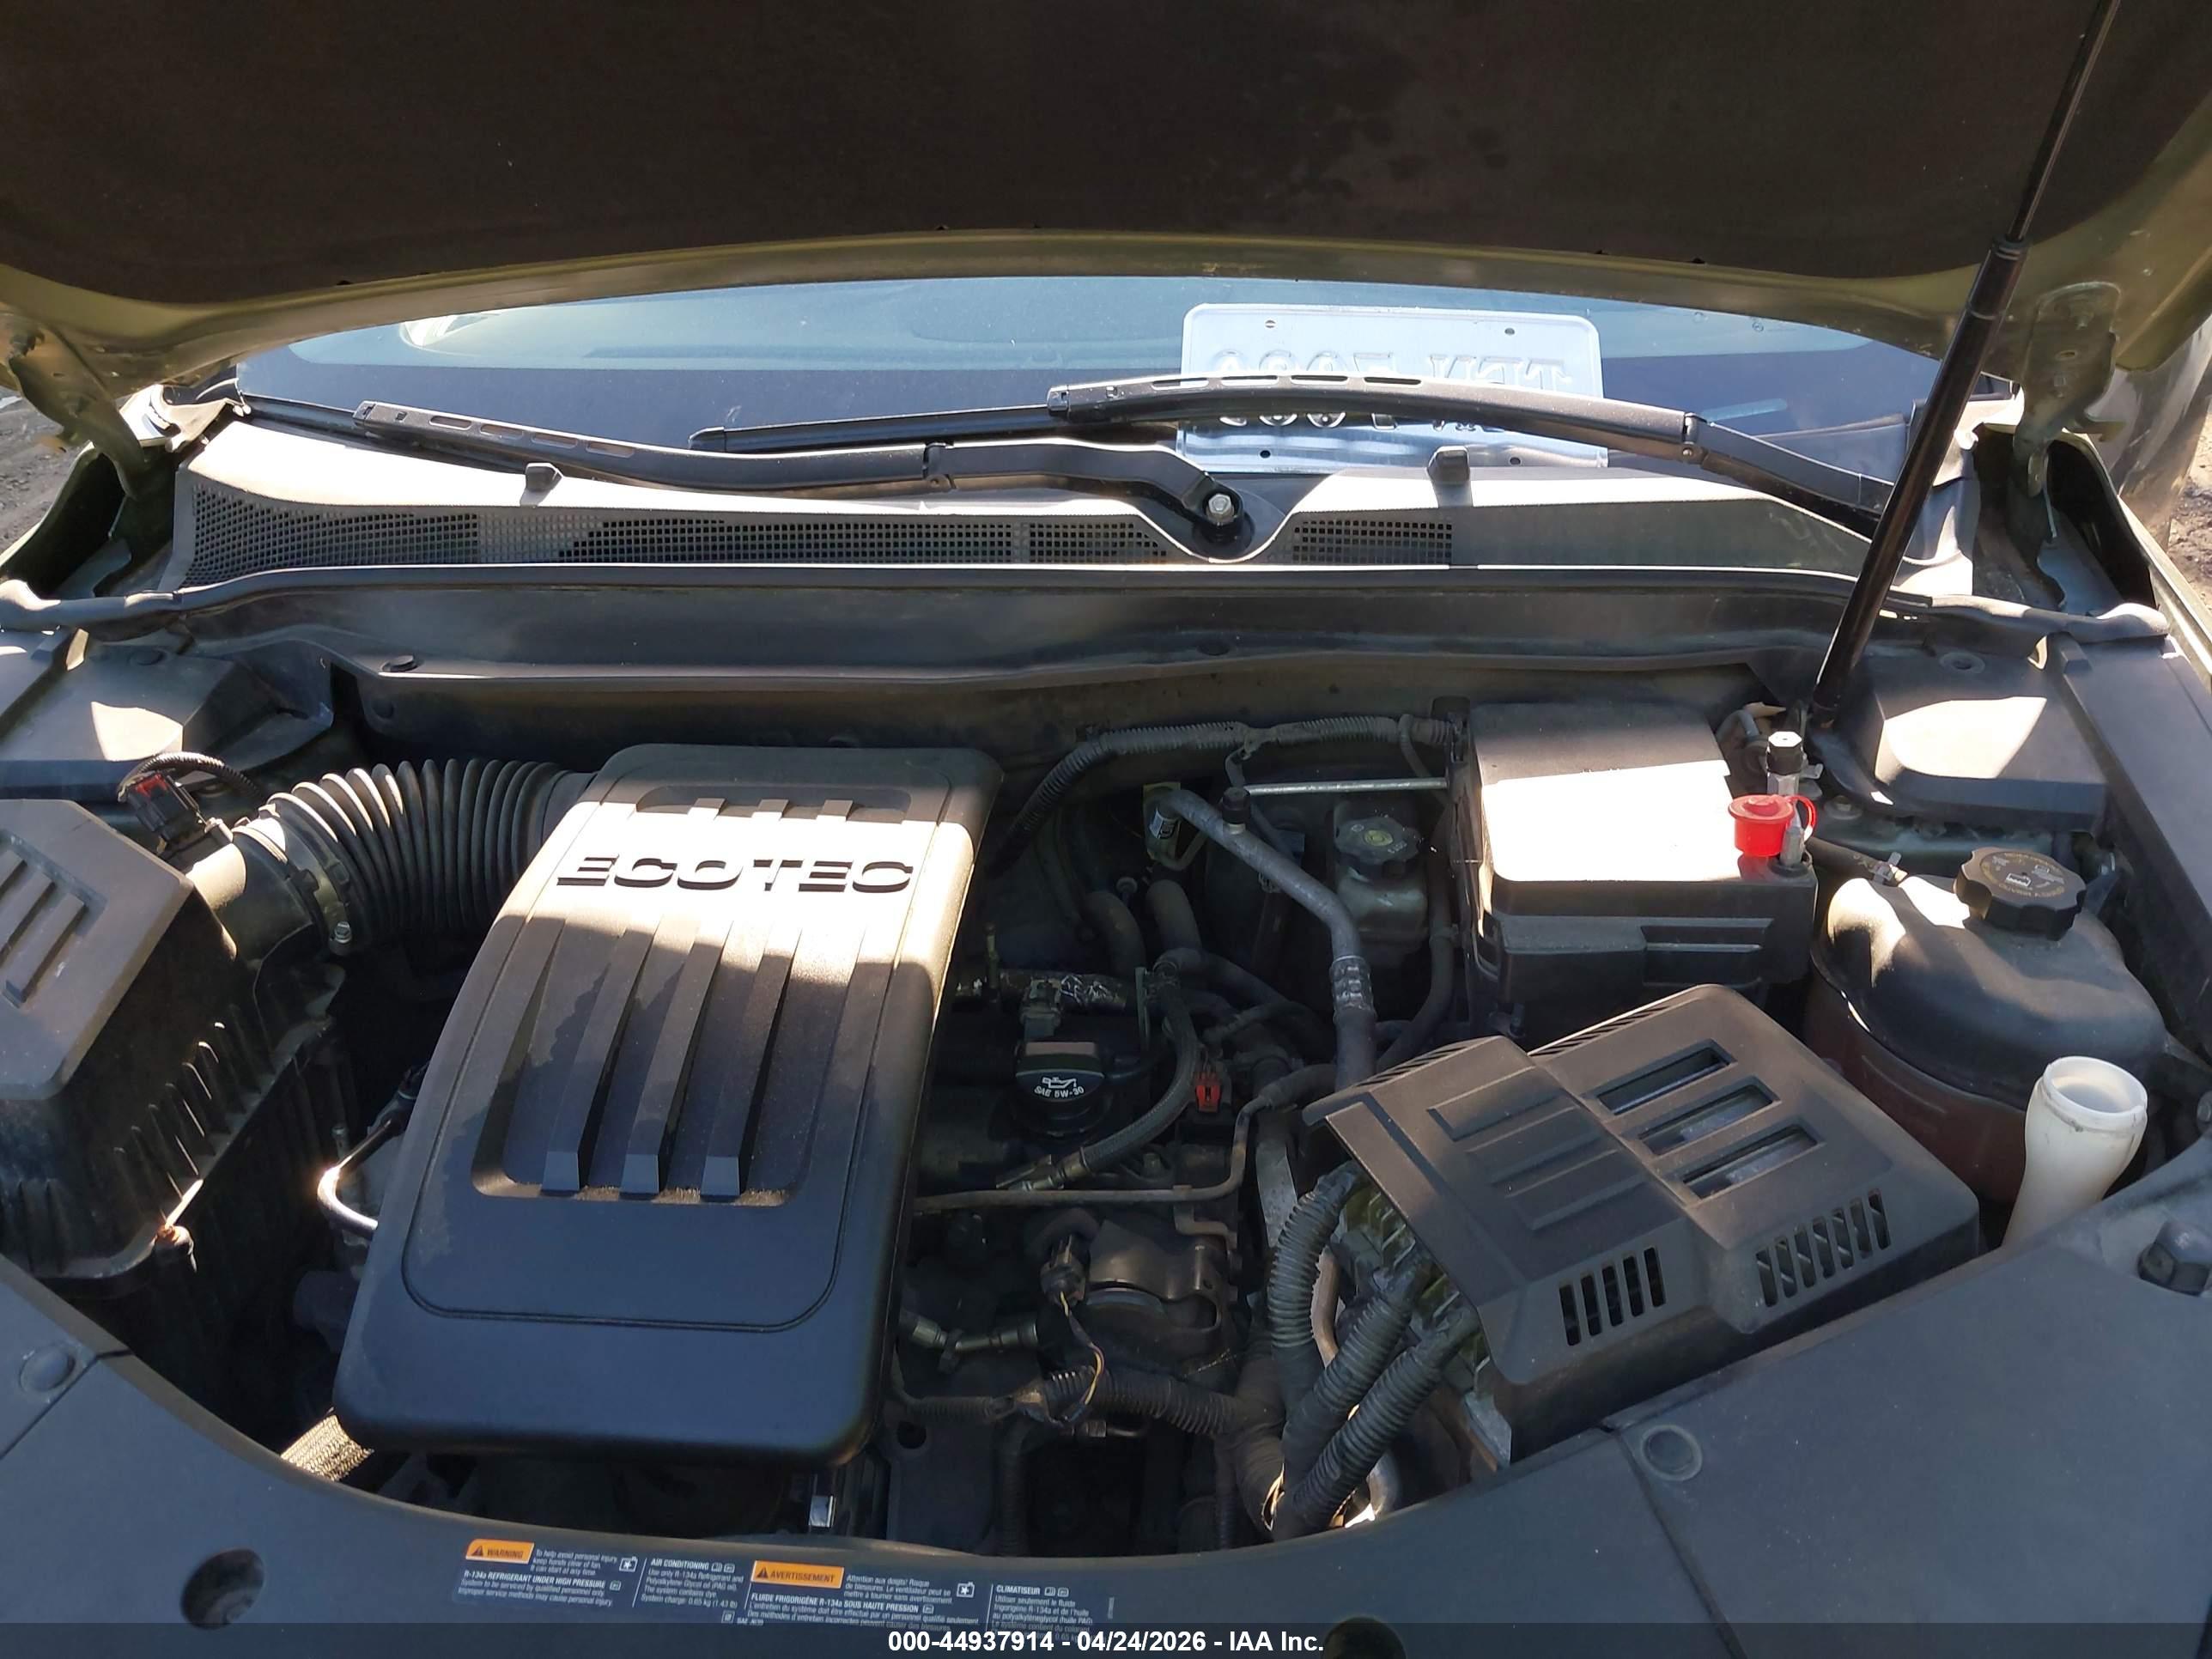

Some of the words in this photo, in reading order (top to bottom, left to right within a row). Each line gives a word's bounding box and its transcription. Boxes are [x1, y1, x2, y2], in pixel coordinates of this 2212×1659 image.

[557, 854, 914, 893] ECOTEC
[1034, 1085, 1051, 1097] SAE
[1054, 1085, 1085, 1097] 5W-30
[487, 1549, 524, 1559] WARNING
[651, 1558, 664, 1566] AIR
[663, 1559, 710, 1571] CONDITIONING
[464, 1571, 488, 1579] R-134a
[487, 1572, 532, 1583] REFRIGERANT
[532, 1576, 555, 1584] UNDER
[556, 1577, 572, 1586] HIGH
[572, 1578, 606, 1589] PRESSURE
[770, 1571, 834, 1583] AVERTISSEMENT
[996, 1584, 1041, 1595] CLIMATISEUR
[751, 1593, 775, 1602] FLUIDE
[819, 1598, 843, 1607] R-134a
[843, 1600, 863, 1609] SOUS
[862, 1601, 885, 1611] HAUTE
[885, 1603, 920, 1613] PRESSION
